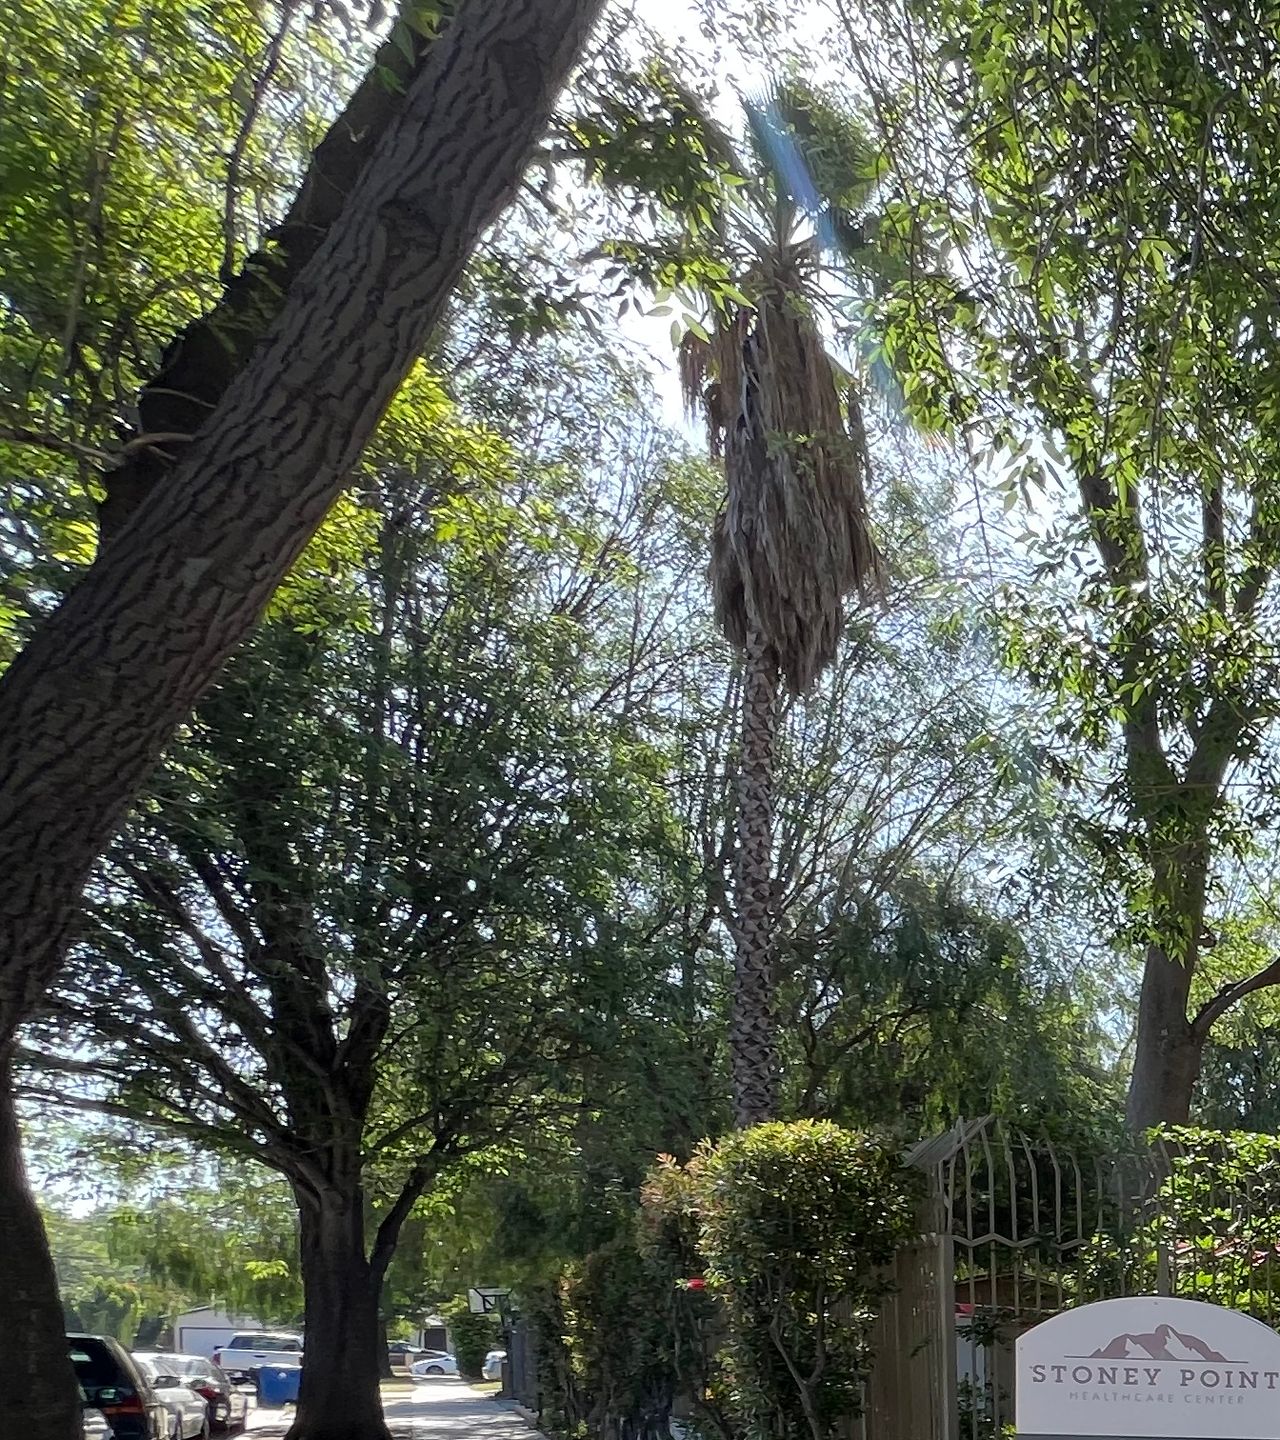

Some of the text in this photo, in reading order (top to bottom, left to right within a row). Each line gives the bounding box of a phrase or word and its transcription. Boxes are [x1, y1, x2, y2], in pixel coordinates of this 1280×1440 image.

[1032, 1364, 1279, 1389] STONEY POINT
[1069, 1391, 1244, 1404] HEALTHCARE CENTER
